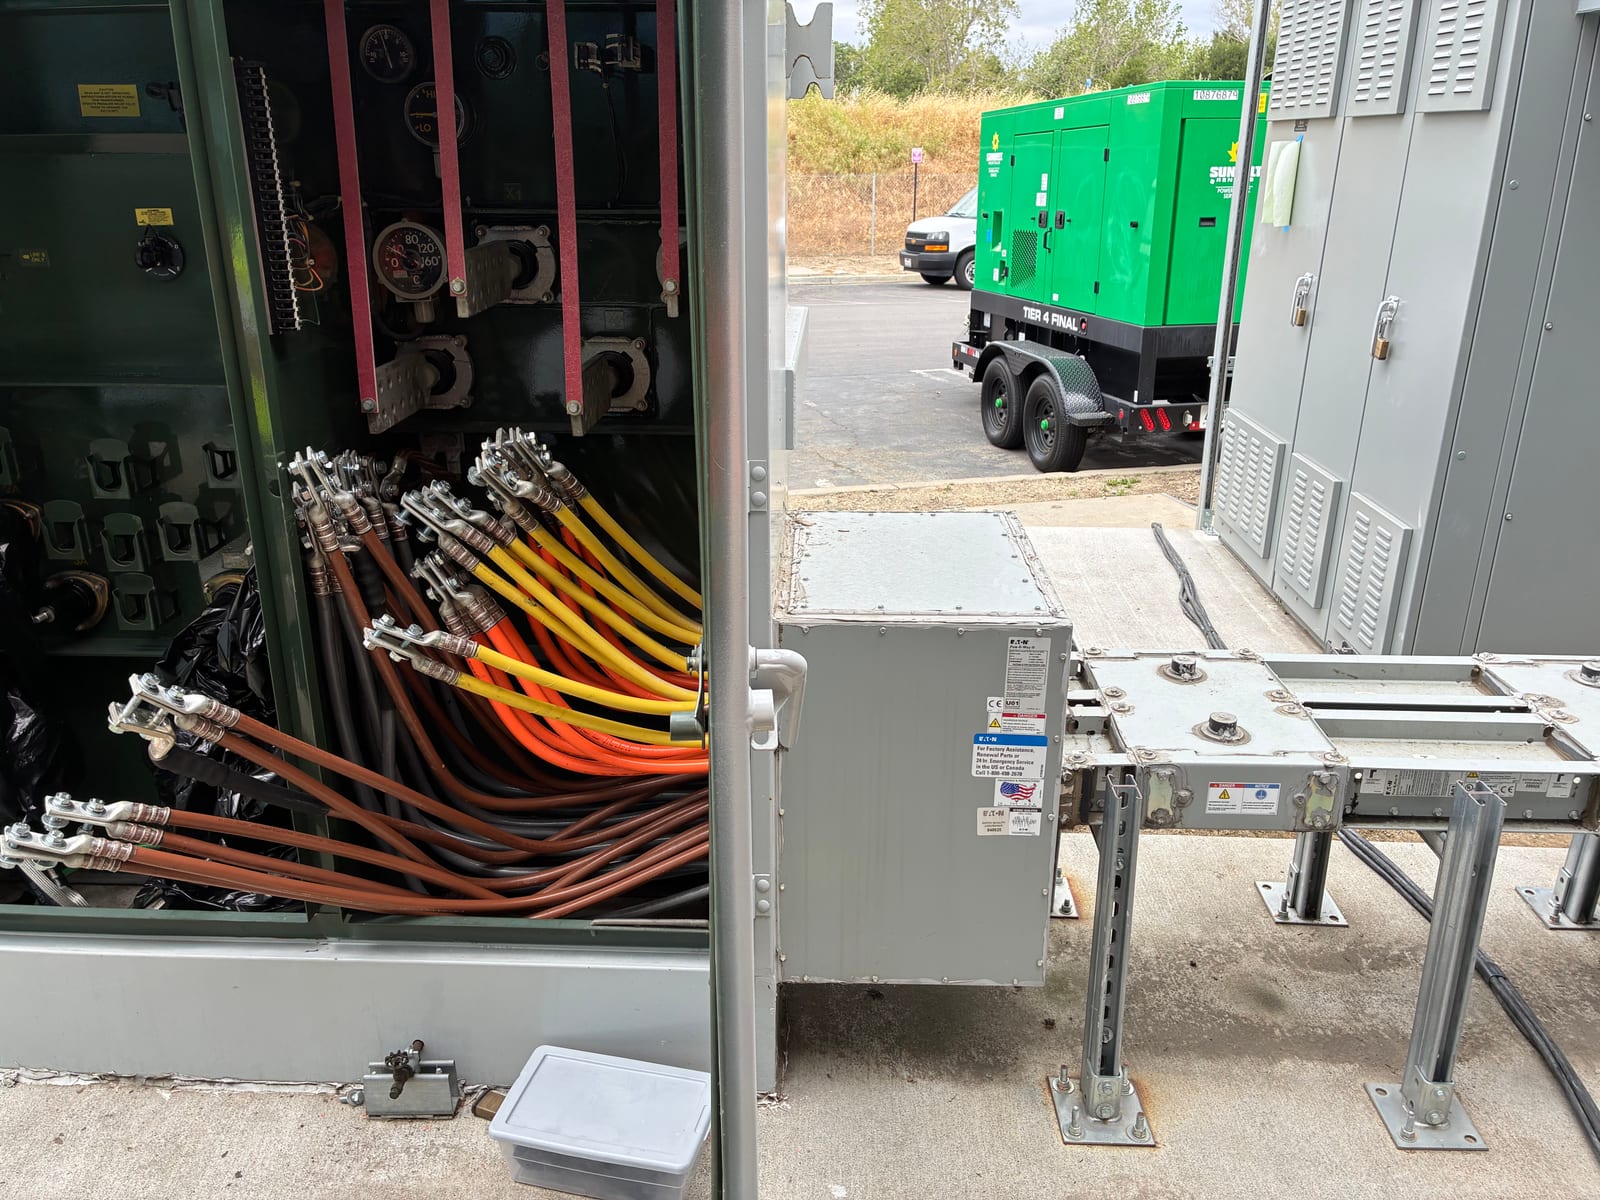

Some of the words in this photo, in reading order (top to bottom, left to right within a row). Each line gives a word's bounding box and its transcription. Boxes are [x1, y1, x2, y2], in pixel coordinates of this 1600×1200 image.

[1195, 90, 1238, 99] 10876879
[420, 124, 431, 132] LO
[1209, 166, 1262, 178] SUNLT
[405, 234, 419, 244] 80
[418, 243, 434, 253] 120
[391, 258, 399, 267] 0
[1023, 306, 1041, 321] TIER
[1043, 311, 1050, 324] 4
[1051, 312, 1078, 331] FINAL
